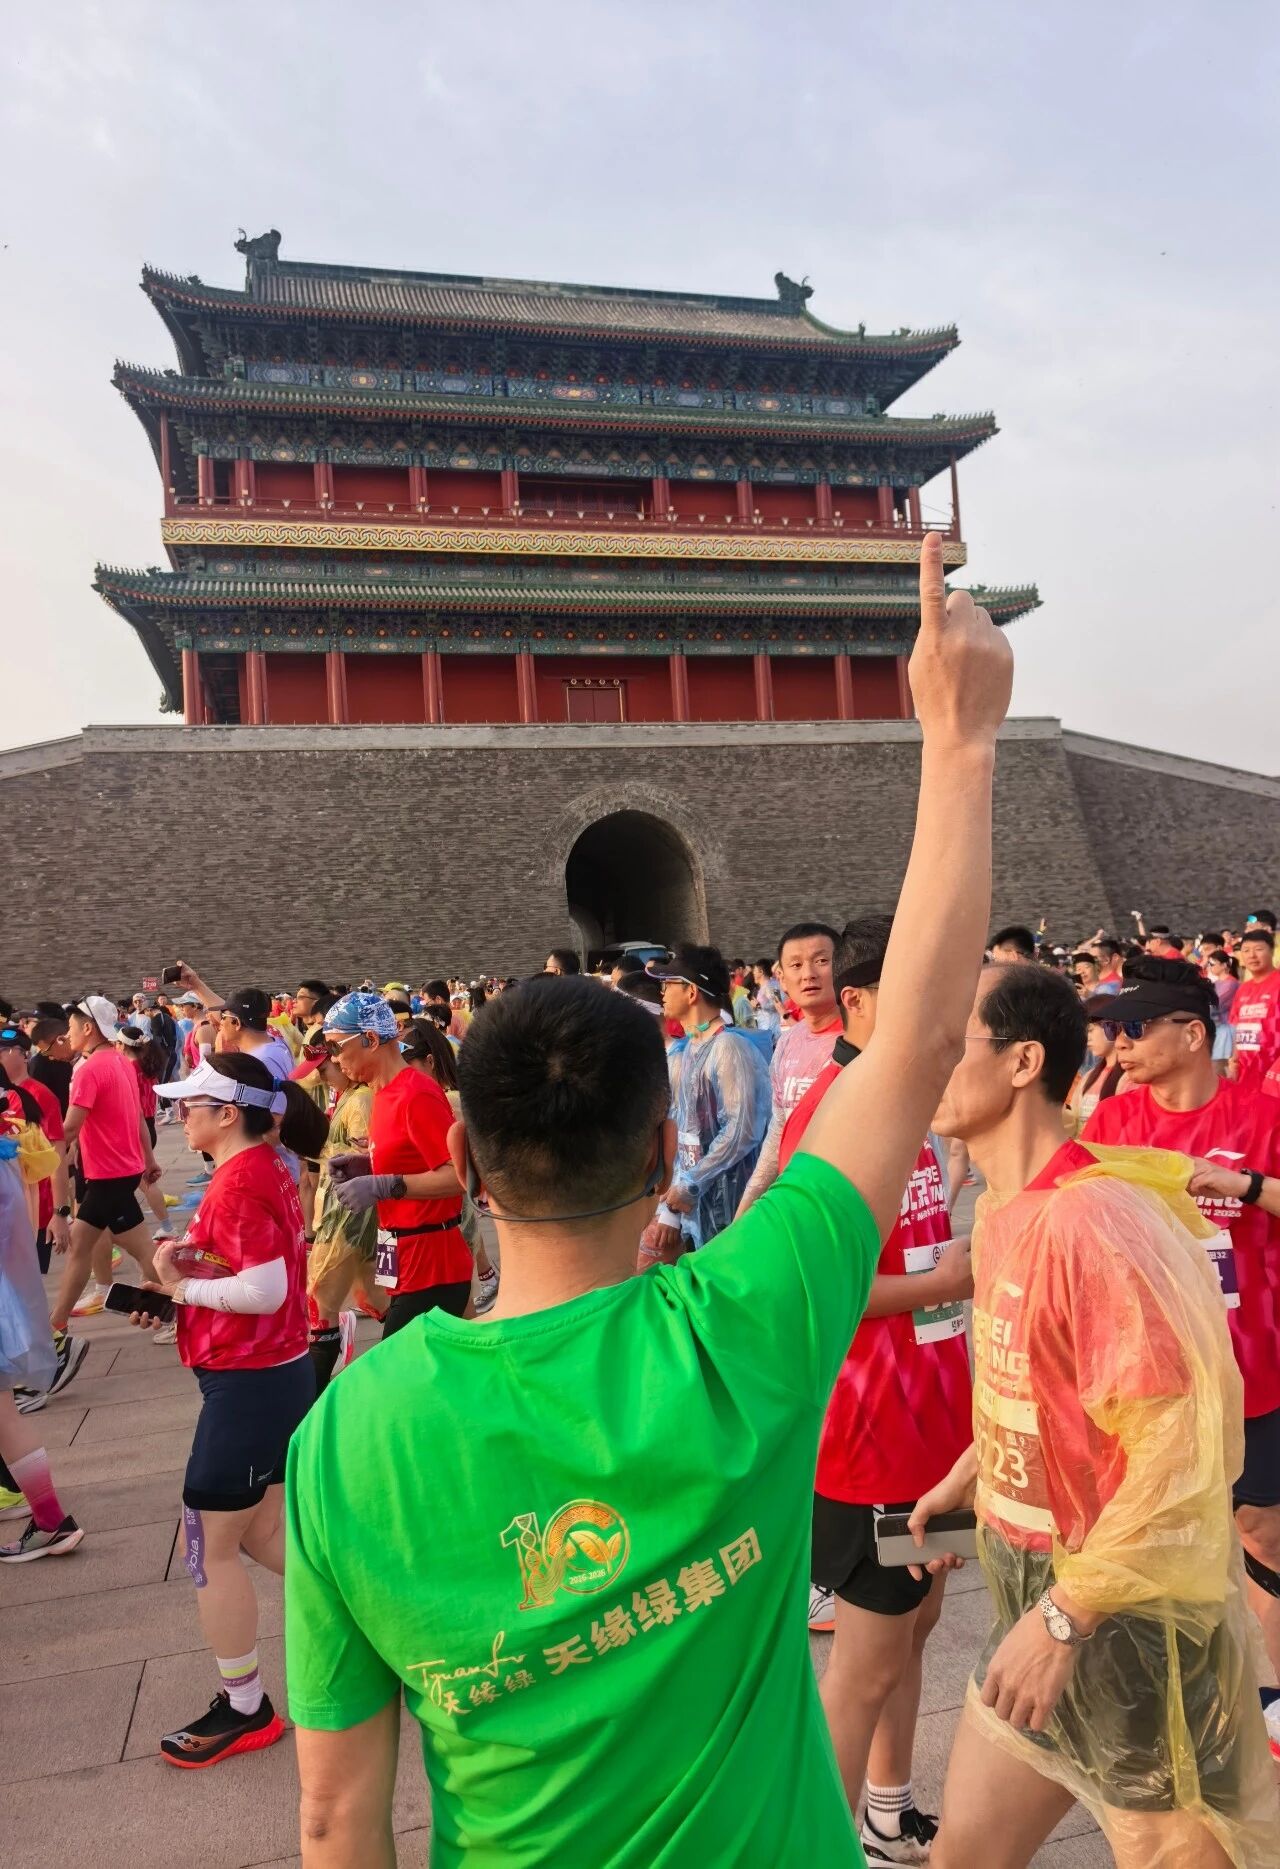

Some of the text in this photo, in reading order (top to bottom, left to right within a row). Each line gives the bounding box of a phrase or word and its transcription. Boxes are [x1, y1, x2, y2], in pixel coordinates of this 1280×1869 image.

[1213, 1208, 1242, 1218] 2026
[542, 1527, 763, 1676] 天缘绿集团
[443, 1669, 537, 1717] 天缘绿
